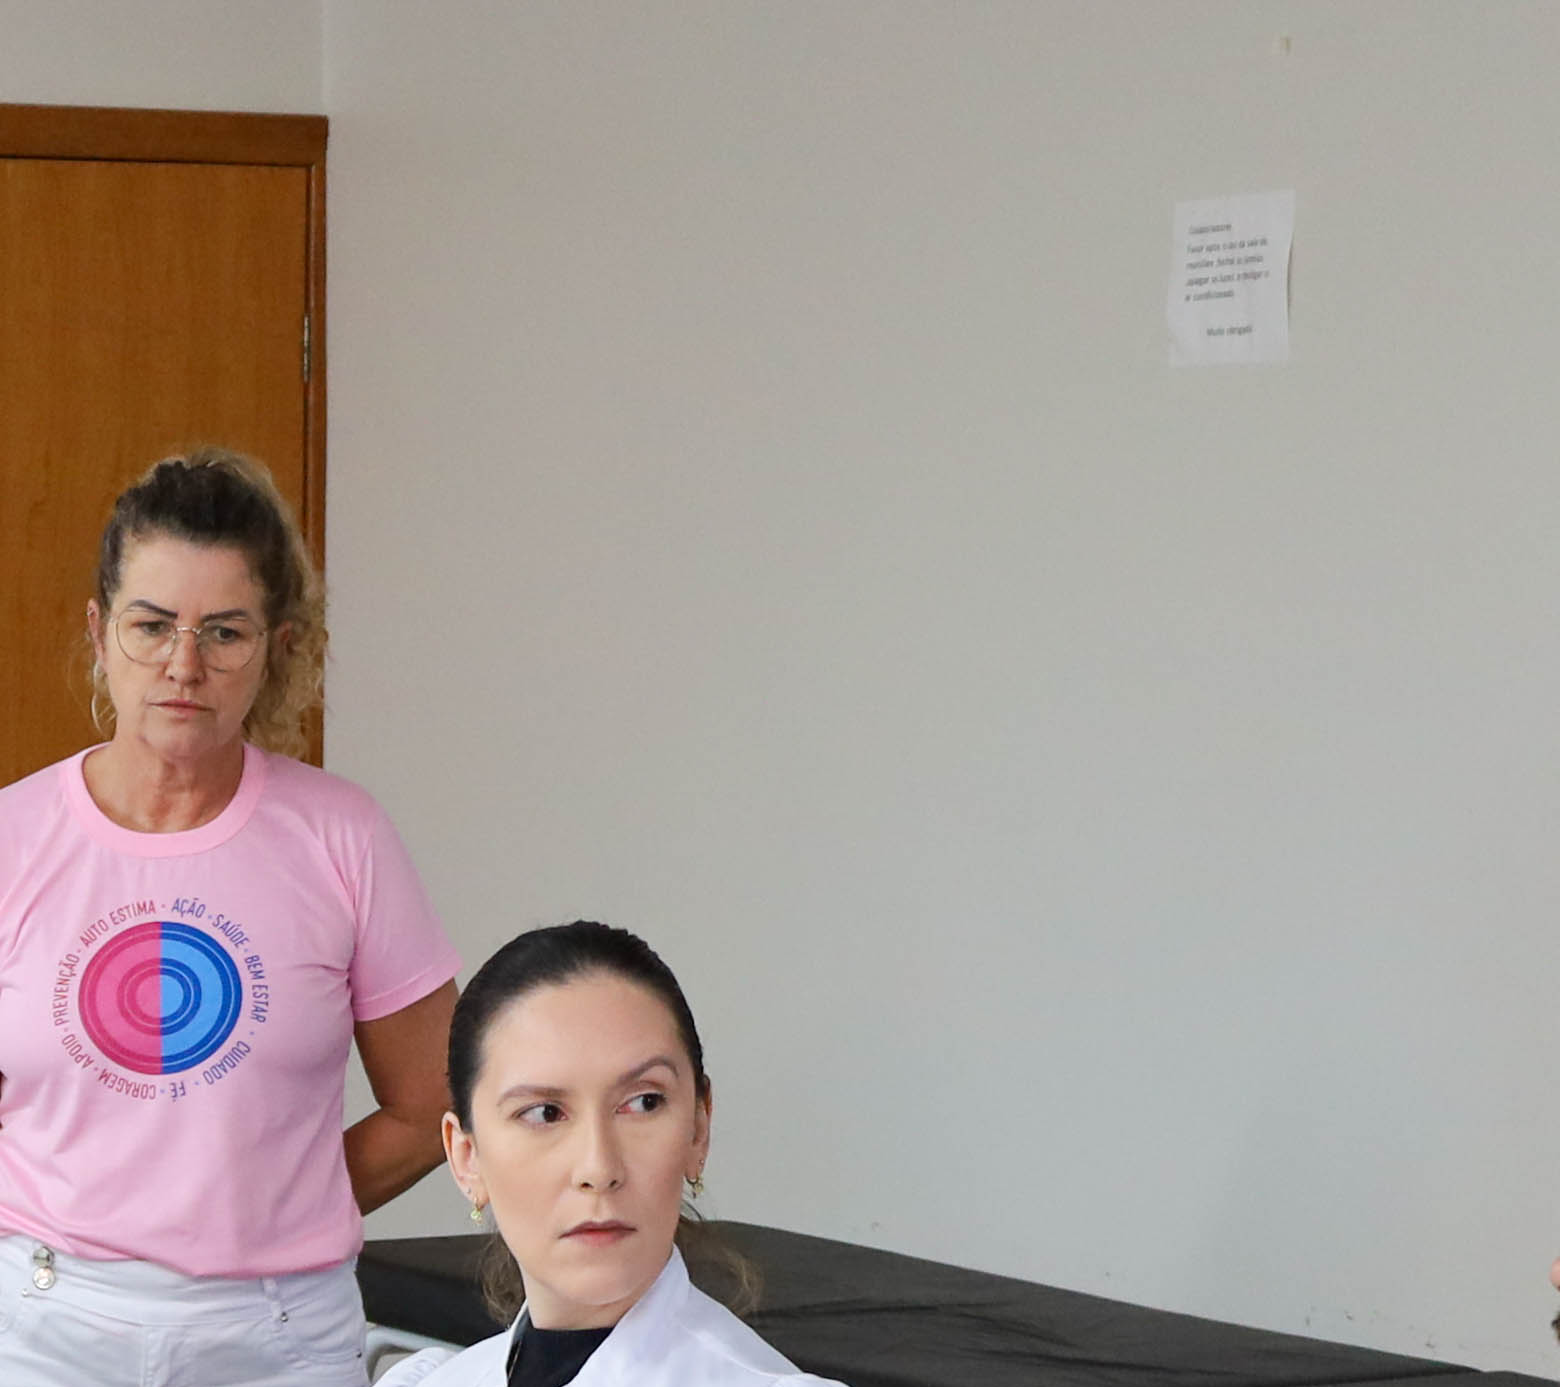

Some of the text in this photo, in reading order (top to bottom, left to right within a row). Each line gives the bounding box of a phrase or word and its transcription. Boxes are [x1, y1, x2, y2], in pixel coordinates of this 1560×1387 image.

[52, 898, 269, 1101] PREVENÇÃO AUTO ESTIMA AÇÃO SAÚDE BEM ESTAR CUIDADO FÉ CORAGEM APOIO
